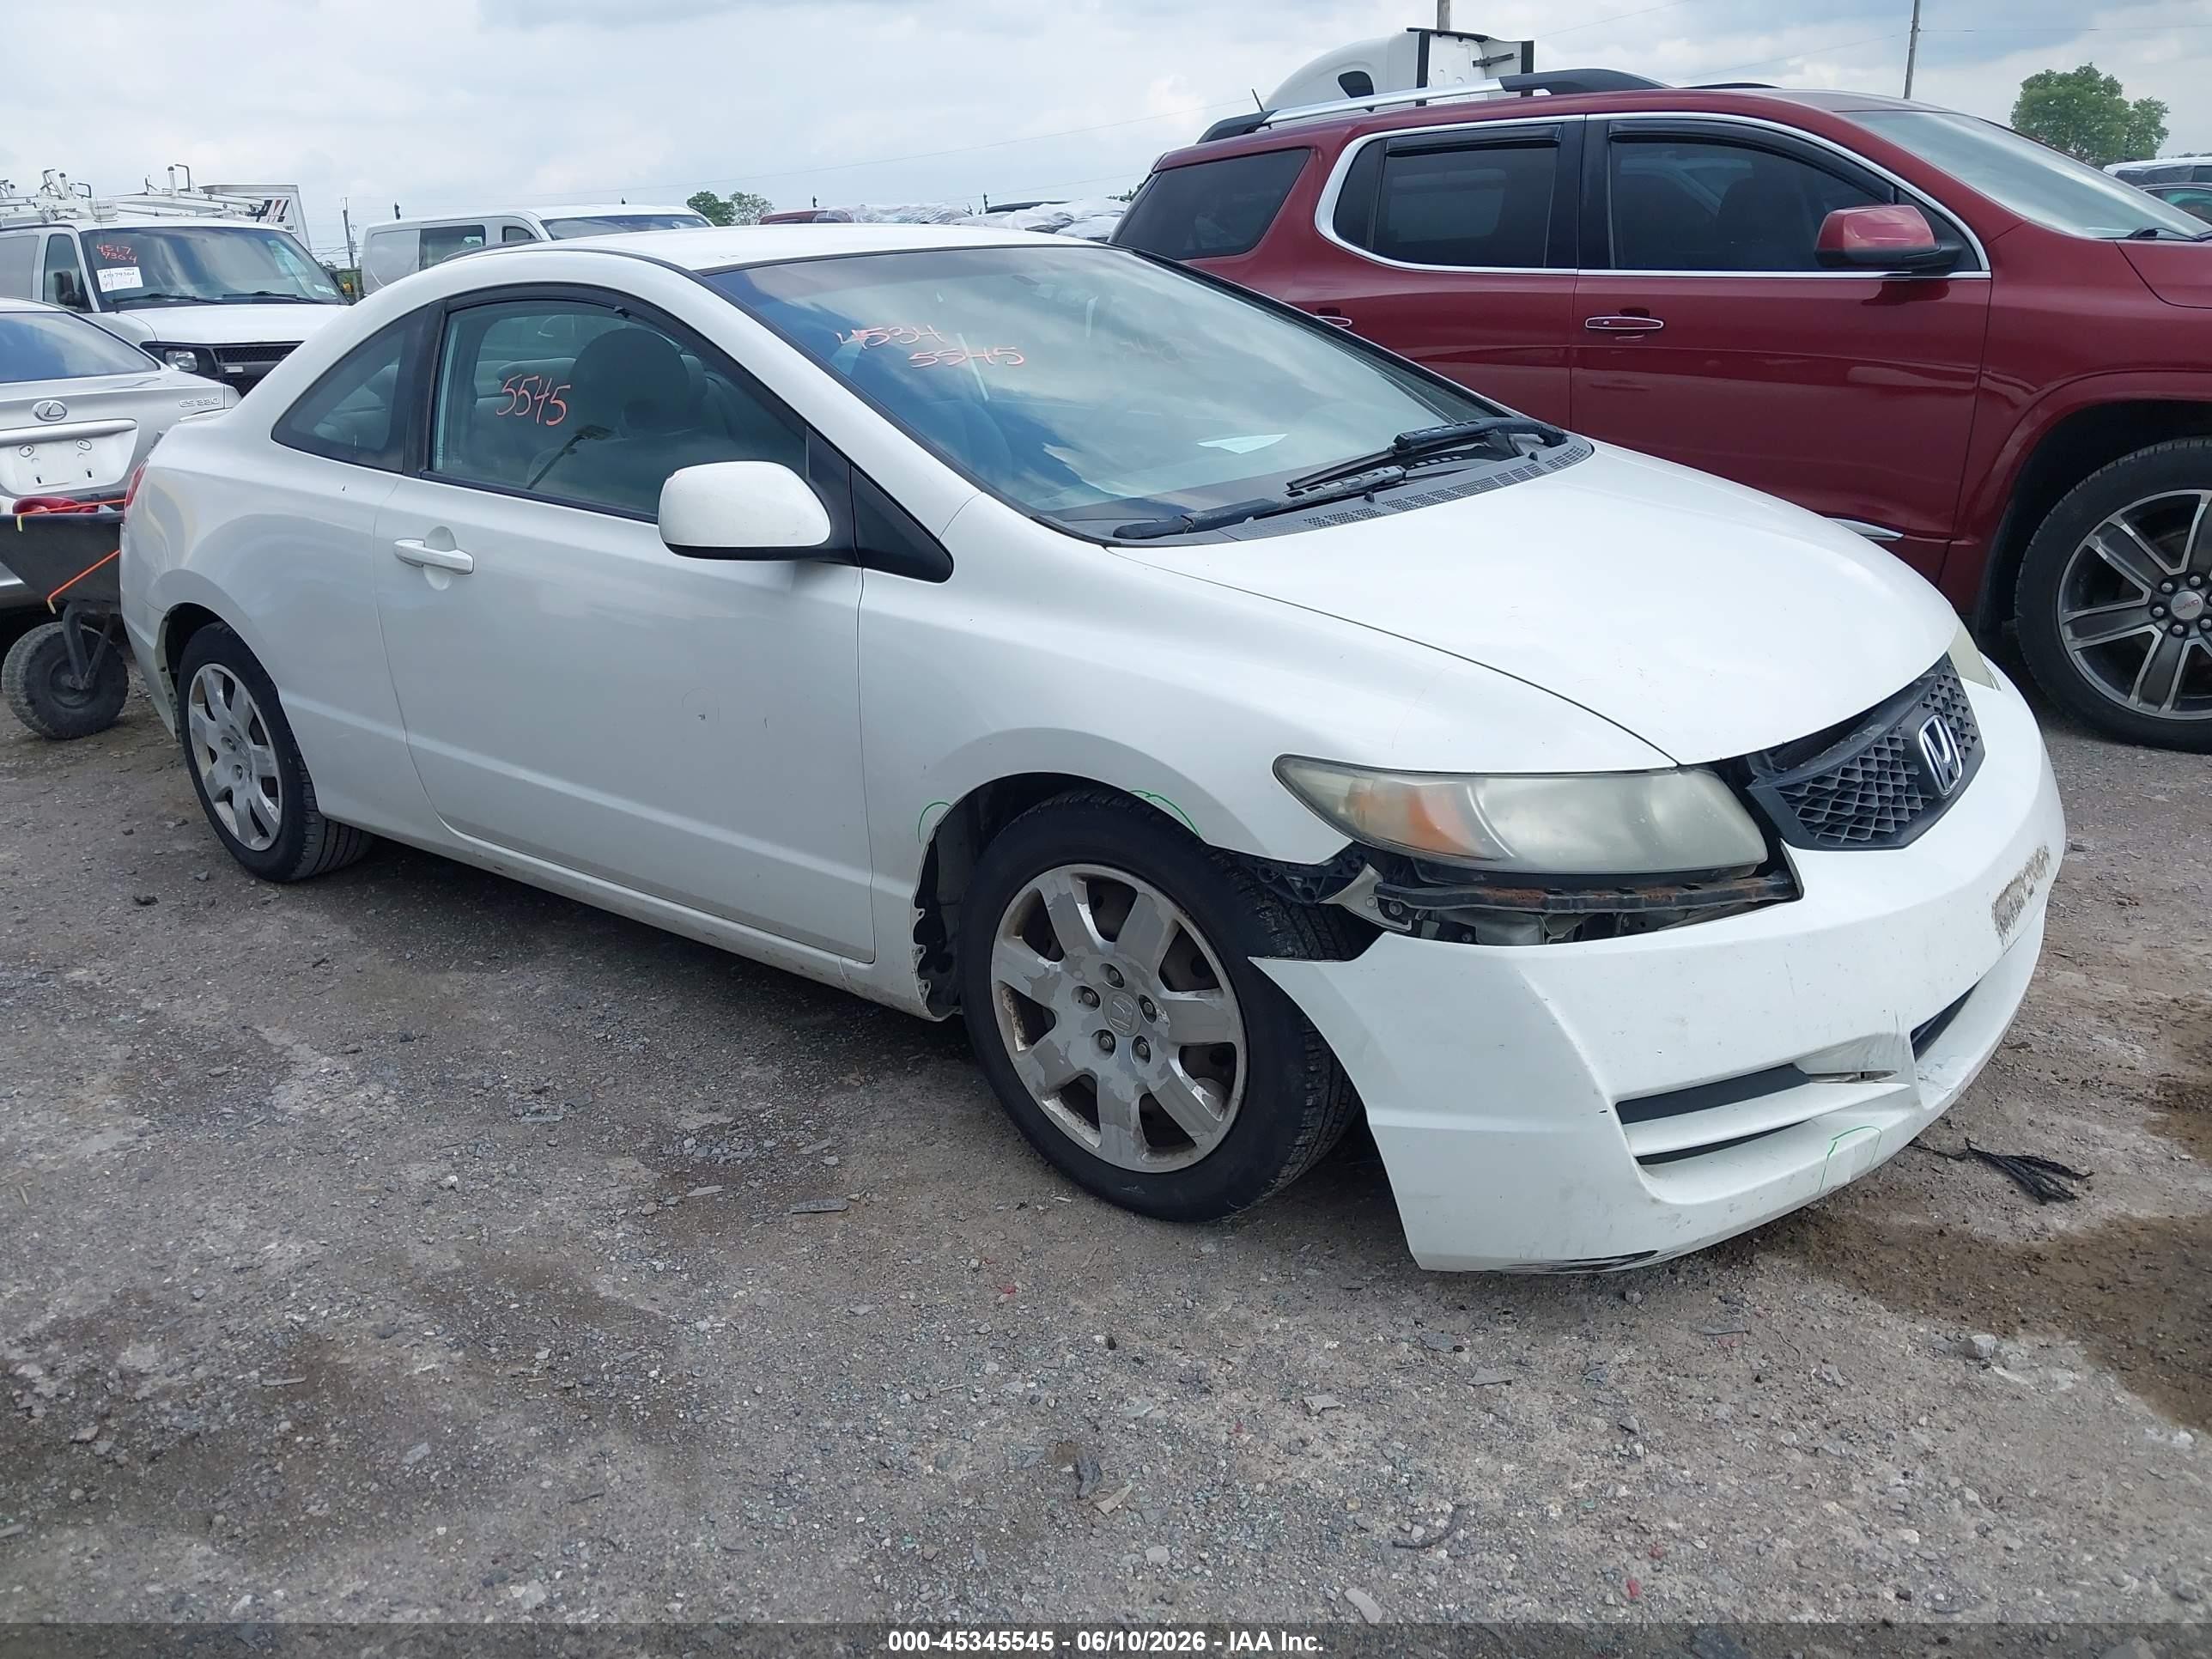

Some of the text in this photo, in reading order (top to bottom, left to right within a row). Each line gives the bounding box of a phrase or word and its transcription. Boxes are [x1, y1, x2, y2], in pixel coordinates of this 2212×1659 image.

[96, 244, 131, 255] 4517
[836, 325, 945, 350] 4534
[908, 346, 1024, 368] 5545
[179, 399, 196, 408] ES
[495, 374, 571, 426] 5545
